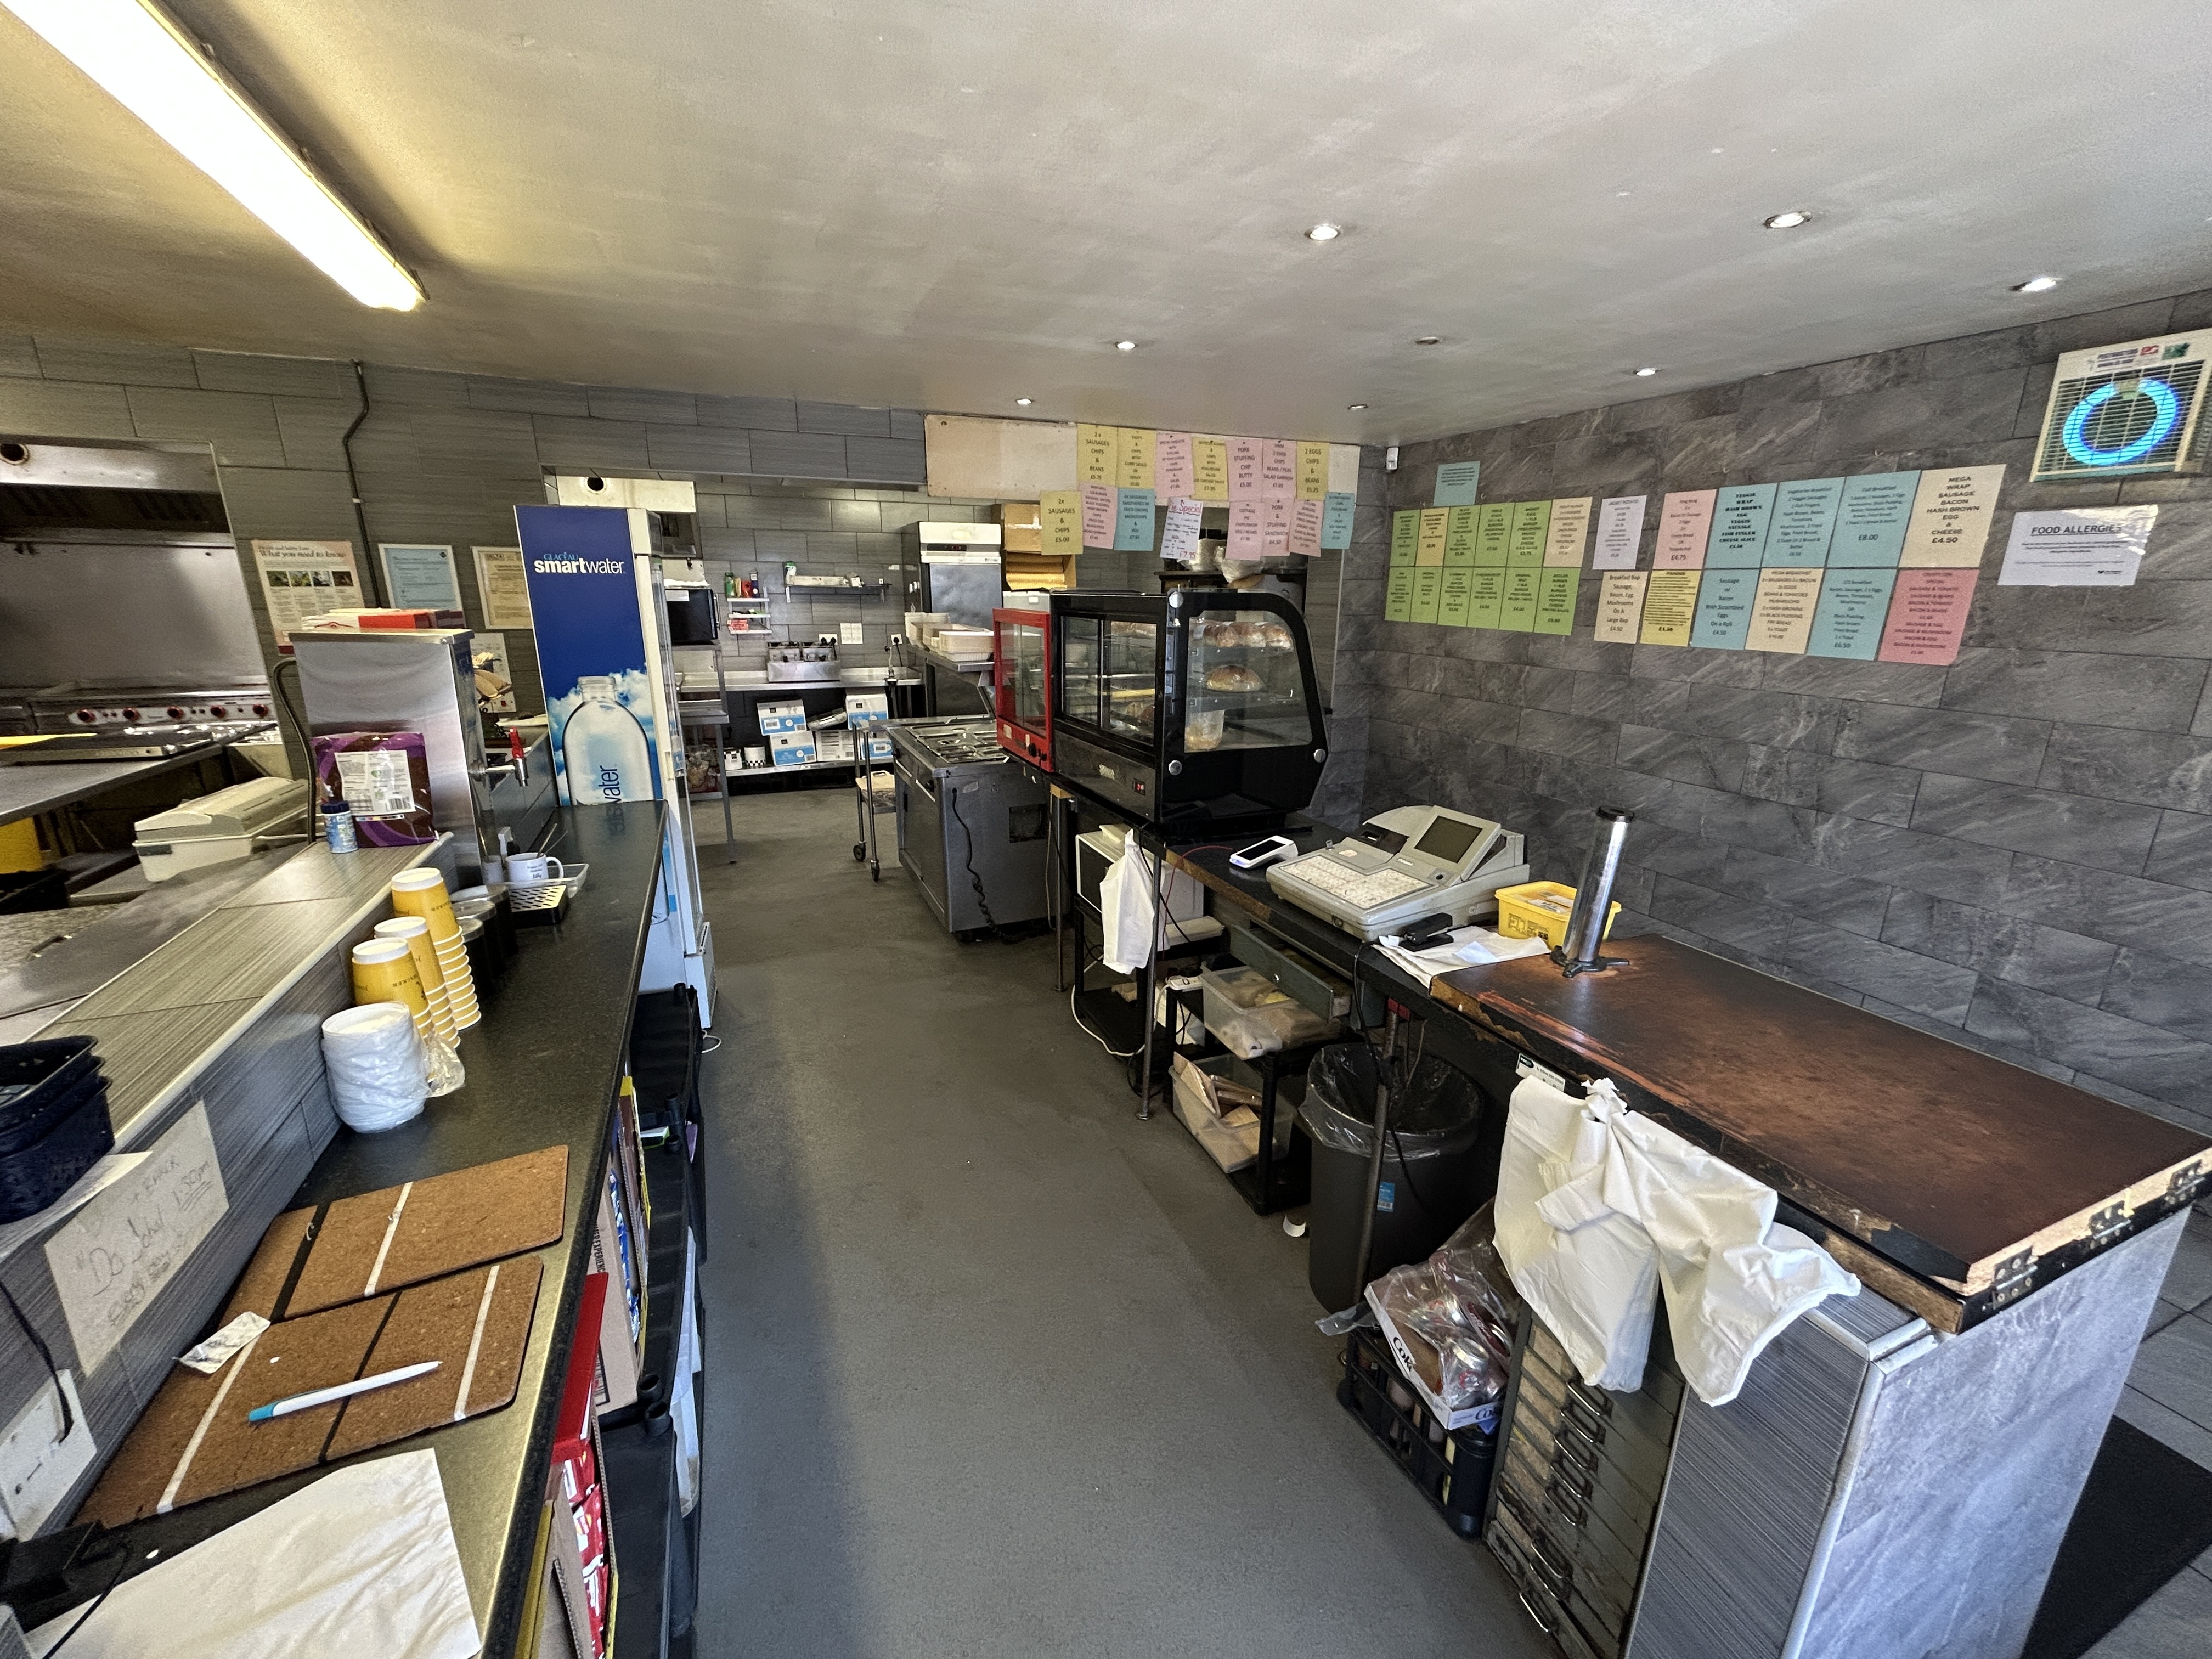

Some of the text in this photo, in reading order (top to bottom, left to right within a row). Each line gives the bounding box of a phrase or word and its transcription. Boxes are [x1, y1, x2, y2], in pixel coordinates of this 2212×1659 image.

[1179, 501, 1202, 515] Special
[2031, 526, 2061, 534] FOOD
[543, 552, 578, 561] GLACÉAU
[534, 557, 625, 574] smartwater
[592, 1239, 606, 1273] EXPERIENC
[1475, 1408, 1493, 1420] Co
